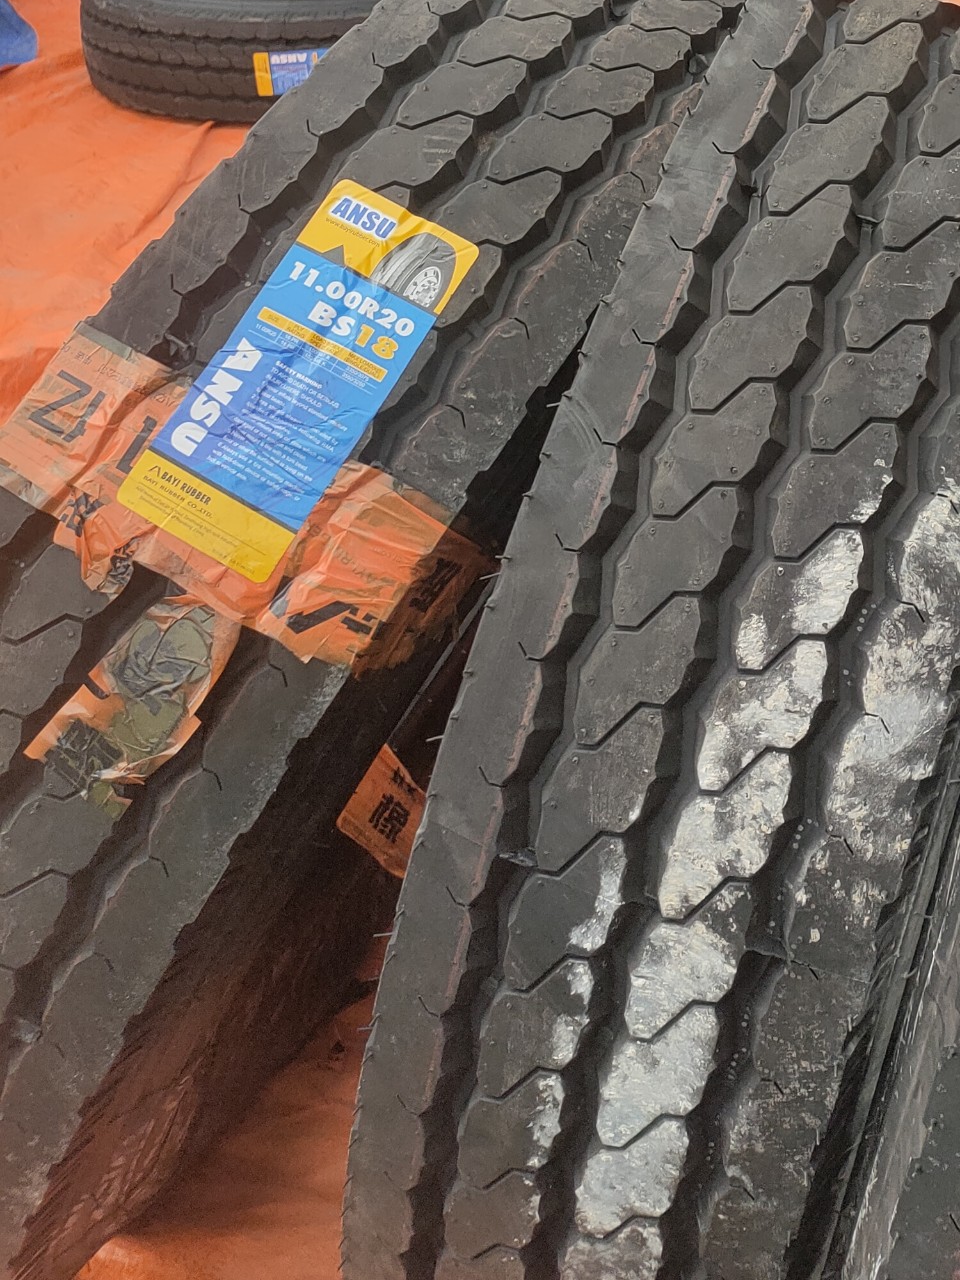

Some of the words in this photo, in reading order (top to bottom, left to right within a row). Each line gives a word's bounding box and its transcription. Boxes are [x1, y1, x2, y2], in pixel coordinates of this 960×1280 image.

[331, 197, 397, 240] ANSU
[289, 261, 415, 337] 11.00R20
[170, 338, 263, 457] ANSU
[160, 471, 181, 487] BAYI
[179, 482, 212, 505] RUBBER
